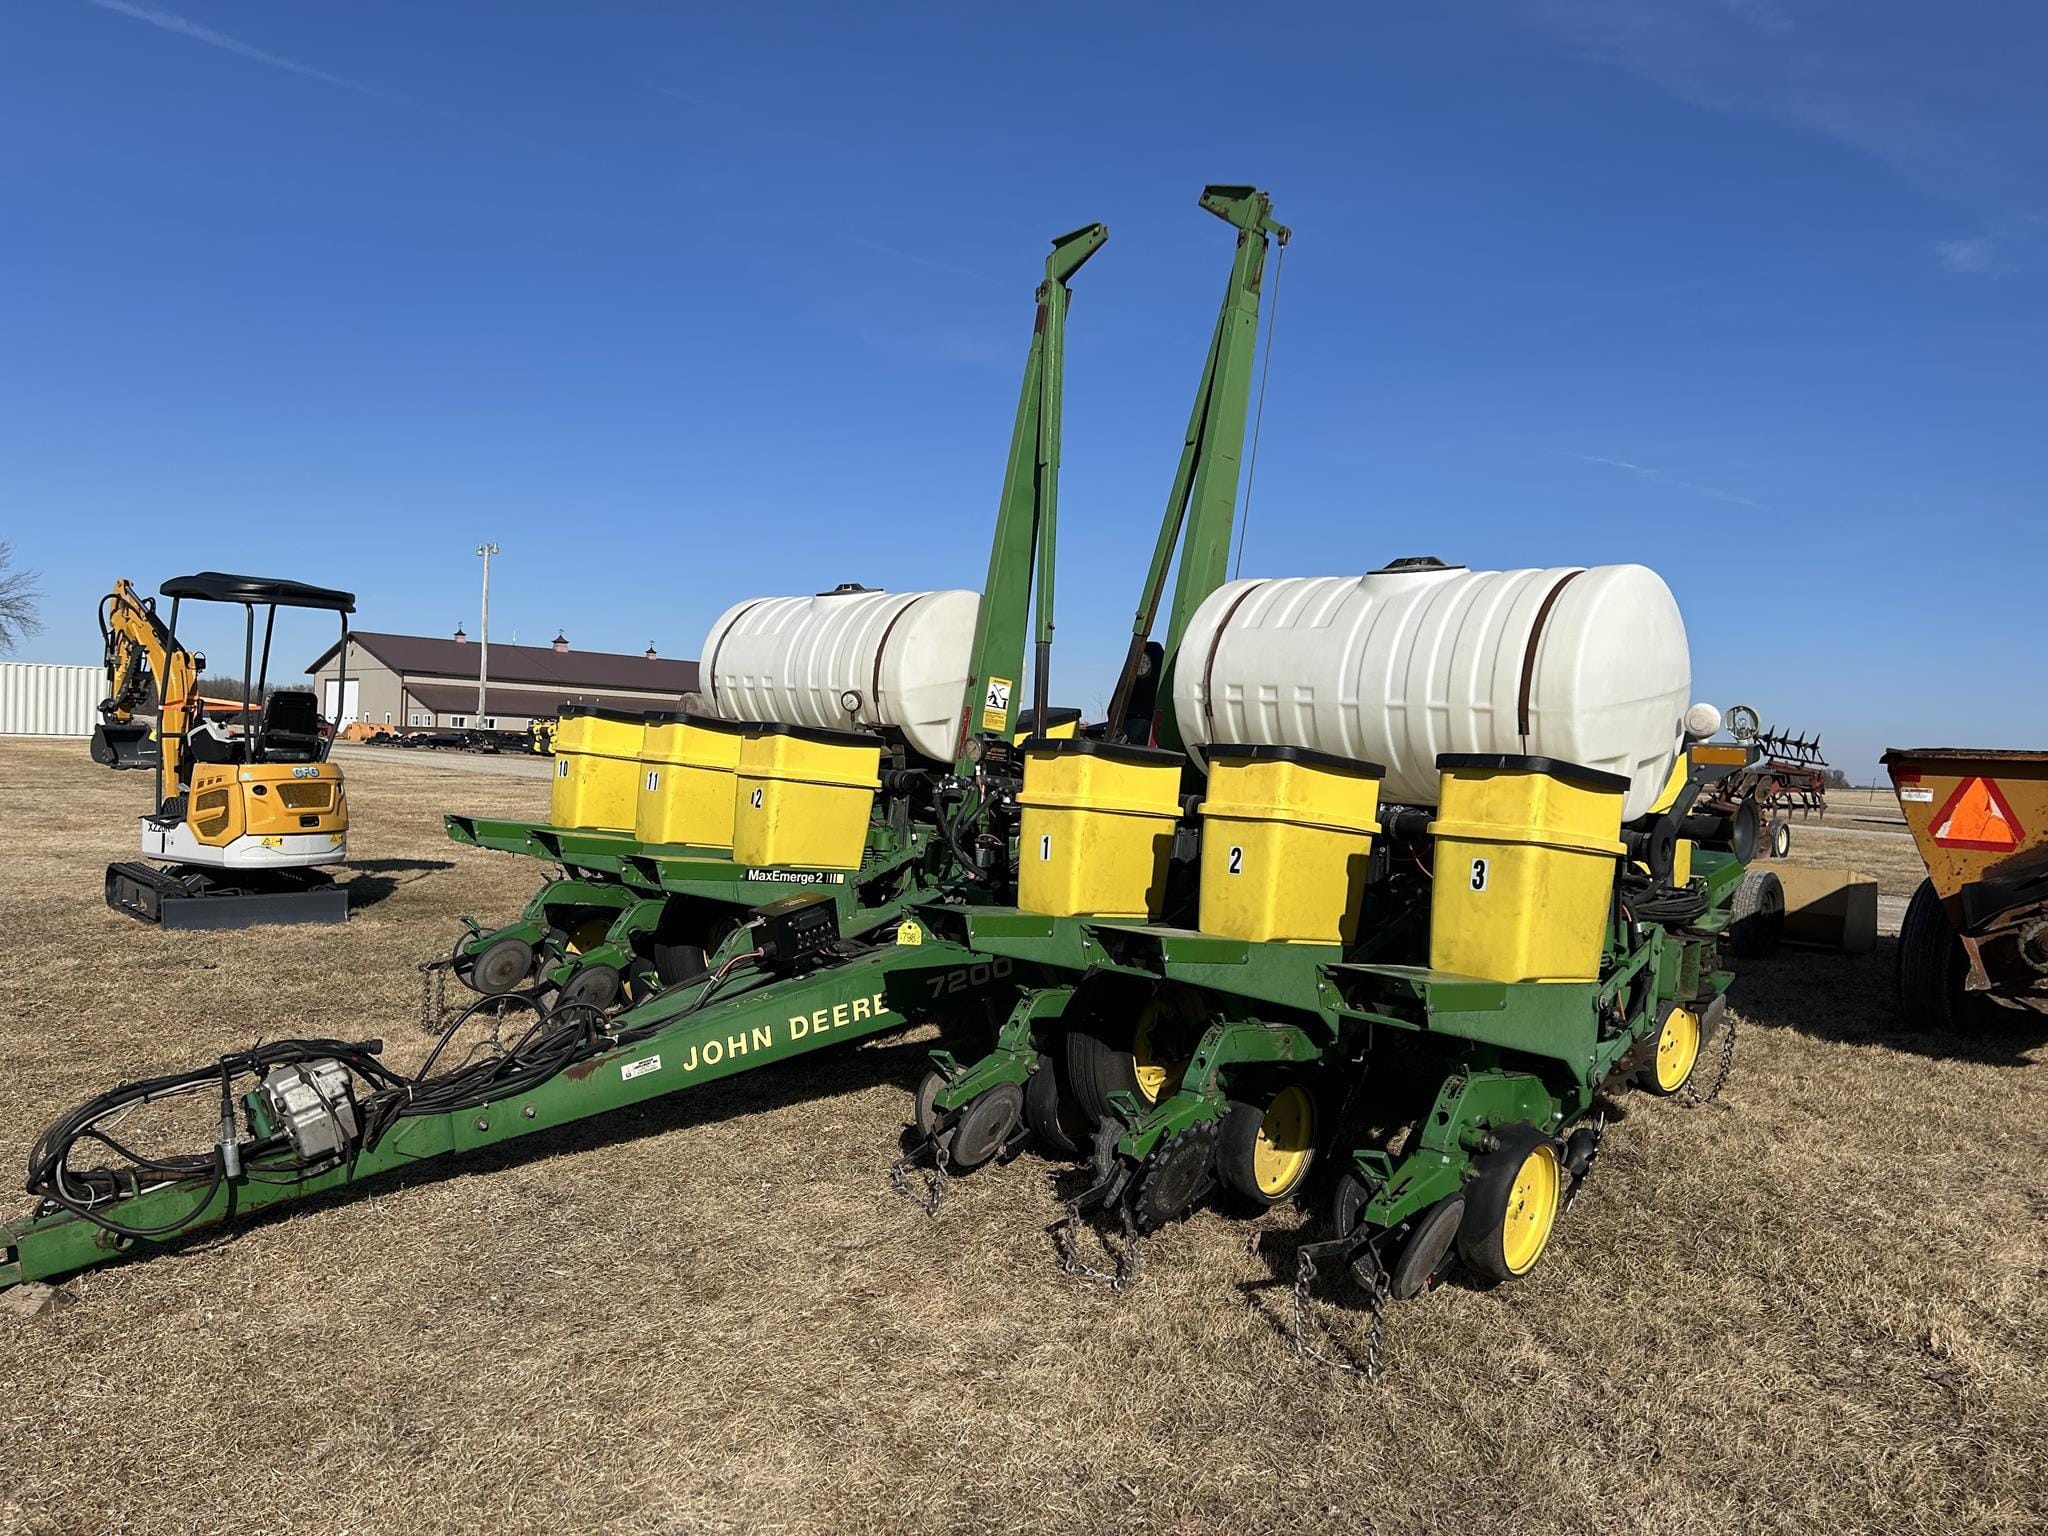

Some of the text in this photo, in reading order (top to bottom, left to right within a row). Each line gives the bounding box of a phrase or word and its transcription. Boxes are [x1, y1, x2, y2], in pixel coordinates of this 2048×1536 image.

[559, 760, 569, 777] 10
[648, 772, 659, 790] 11
[1042, 836, 1050, 861] 1
[1229, 847, 1242, 874] 2
[748, 869, 824, 885] MaxEmerge 2
[1472, 859, 1486, 890] 3
[926, 957, 1013, 999] 7200
[682, 992, 890, 1072] JOHN DEERE
